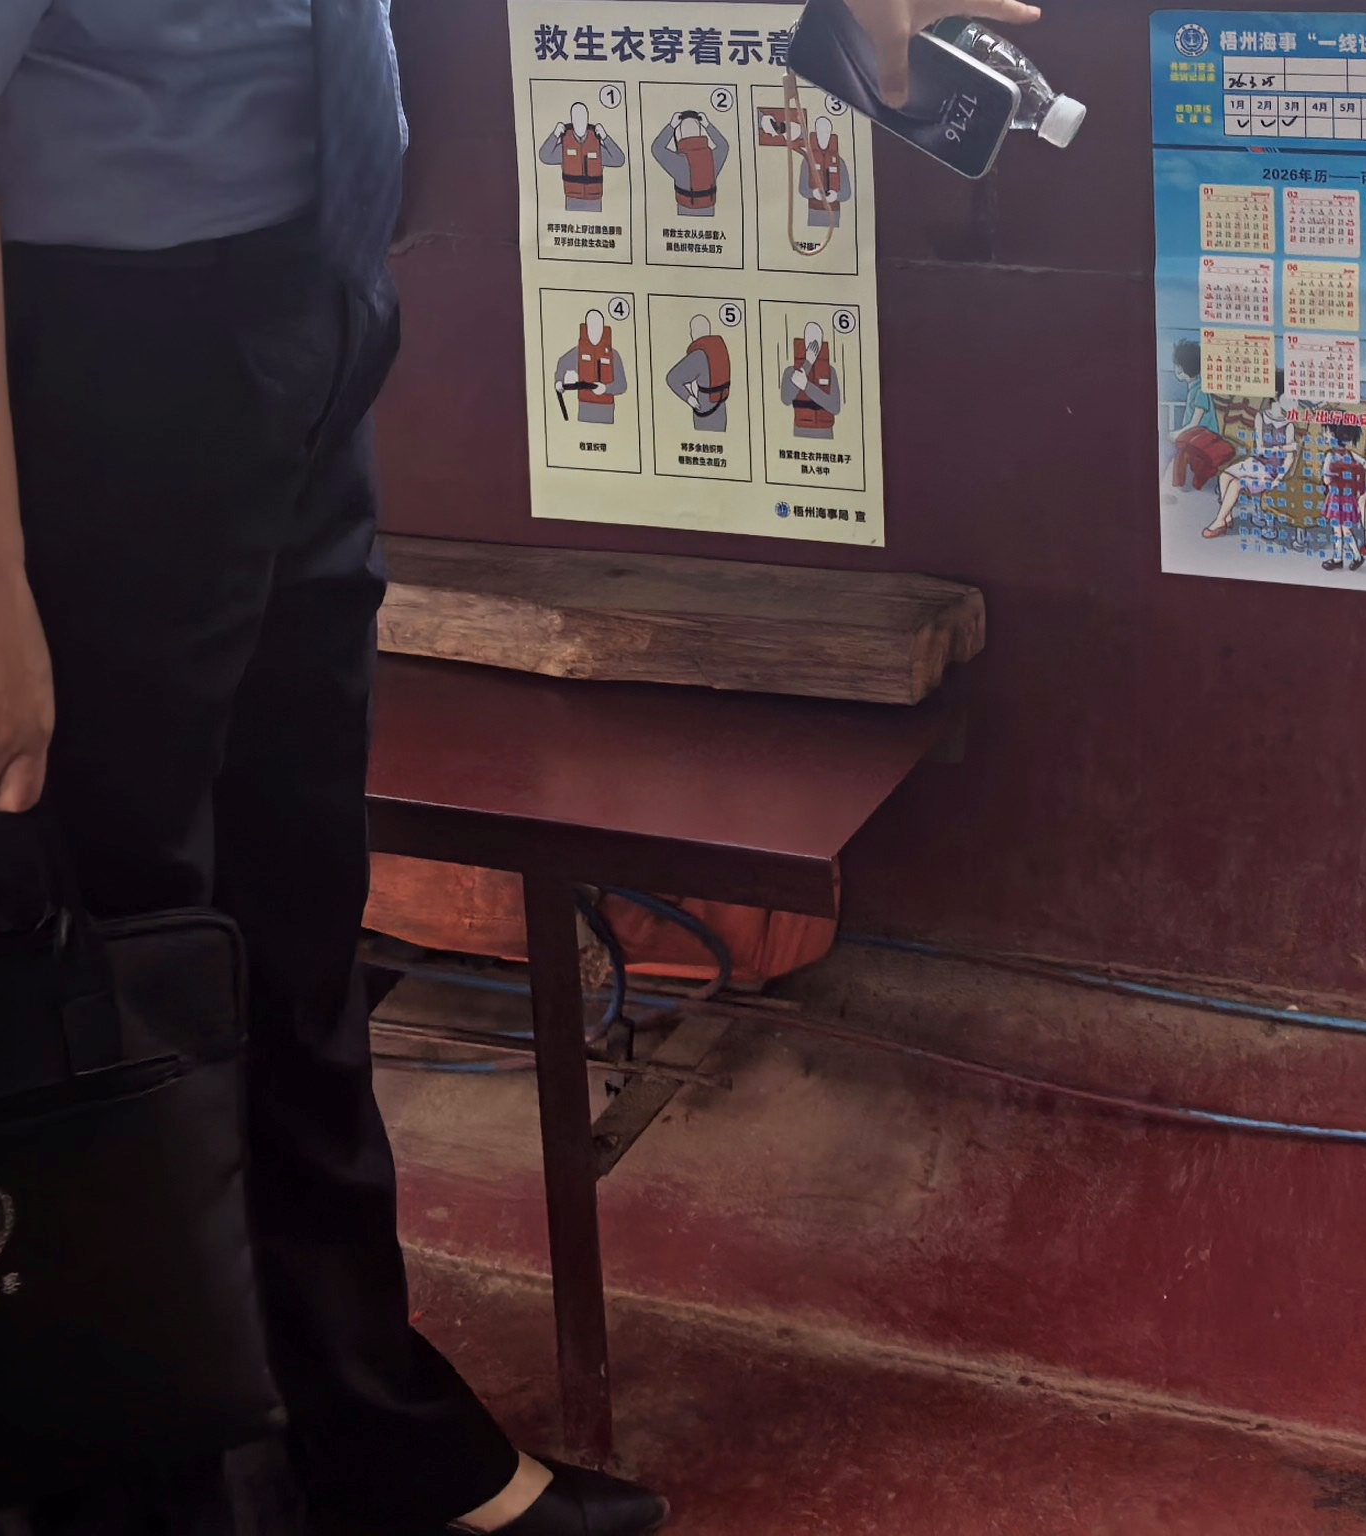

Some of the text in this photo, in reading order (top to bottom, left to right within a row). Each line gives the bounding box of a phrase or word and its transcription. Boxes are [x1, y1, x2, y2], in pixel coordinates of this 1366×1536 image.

[1219, 30, 1297, 53] 梧州海事
[1230, 100, 1245, 111] 1月
[1256, 100, 1272, 111] 2月
[1284, 101, 1299, 112] 3月
[1311, 101, 1327, 112] 4月
[1339, 102, 1355, 113] 5月
[1203, 187, 1214, 195] 01
[1287, 191, 1298, 199] 02
[1203, 259, 1214, 267] 05
[1287, 335, 1298, 344] 10
[793, 505, 866, 523] 梧州海事局 宣
